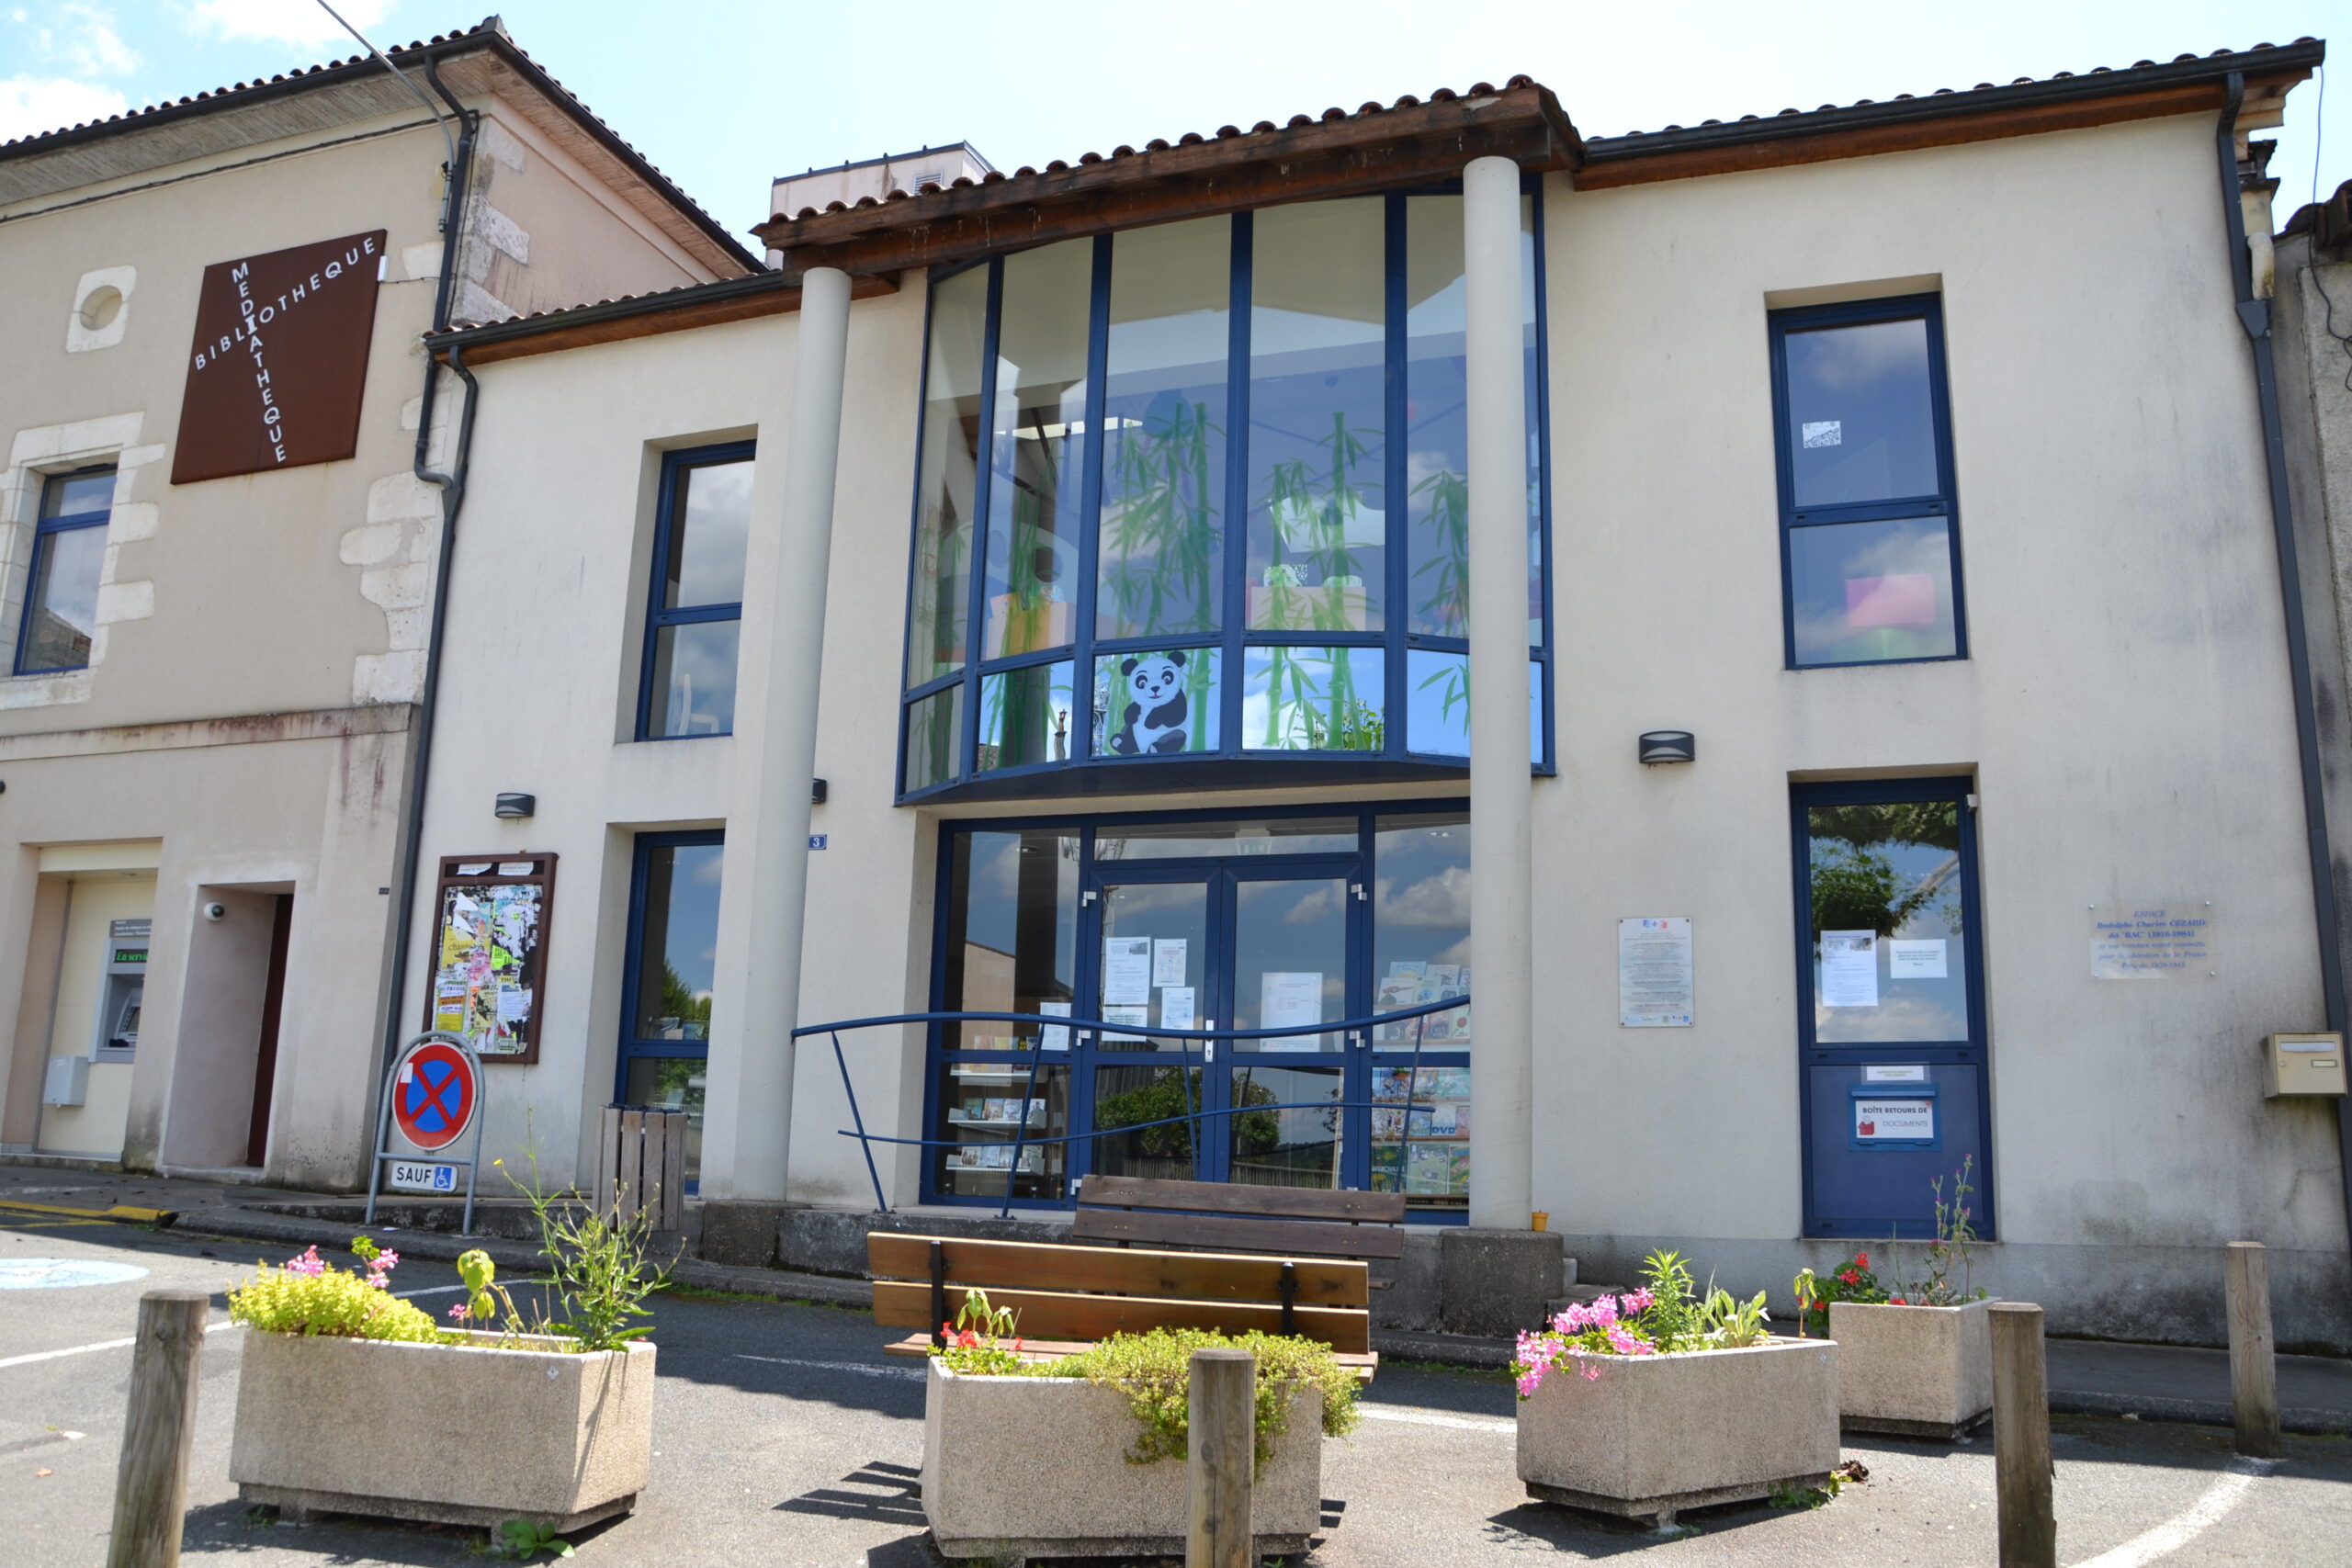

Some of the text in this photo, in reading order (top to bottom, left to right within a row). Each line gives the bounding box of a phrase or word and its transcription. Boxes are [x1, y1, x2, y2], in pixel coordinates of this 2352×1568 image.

[195, 237, 376, 371] BIBLIOTHEQUE
[232, 261, 287, 463] MEDIATHEQUE
[813, 837, 820, 848] 3
[2133, 909, 2167, 918] ESPACE
[2097, 921, 2132, 930] Rodolphe
[2136, 919, 2166, 928] Charles
[2184, 950, 2208, 958] France
[1431, 1126, 1456, 1134] DVD
[396, 1167, 432, 1183] SAUF
